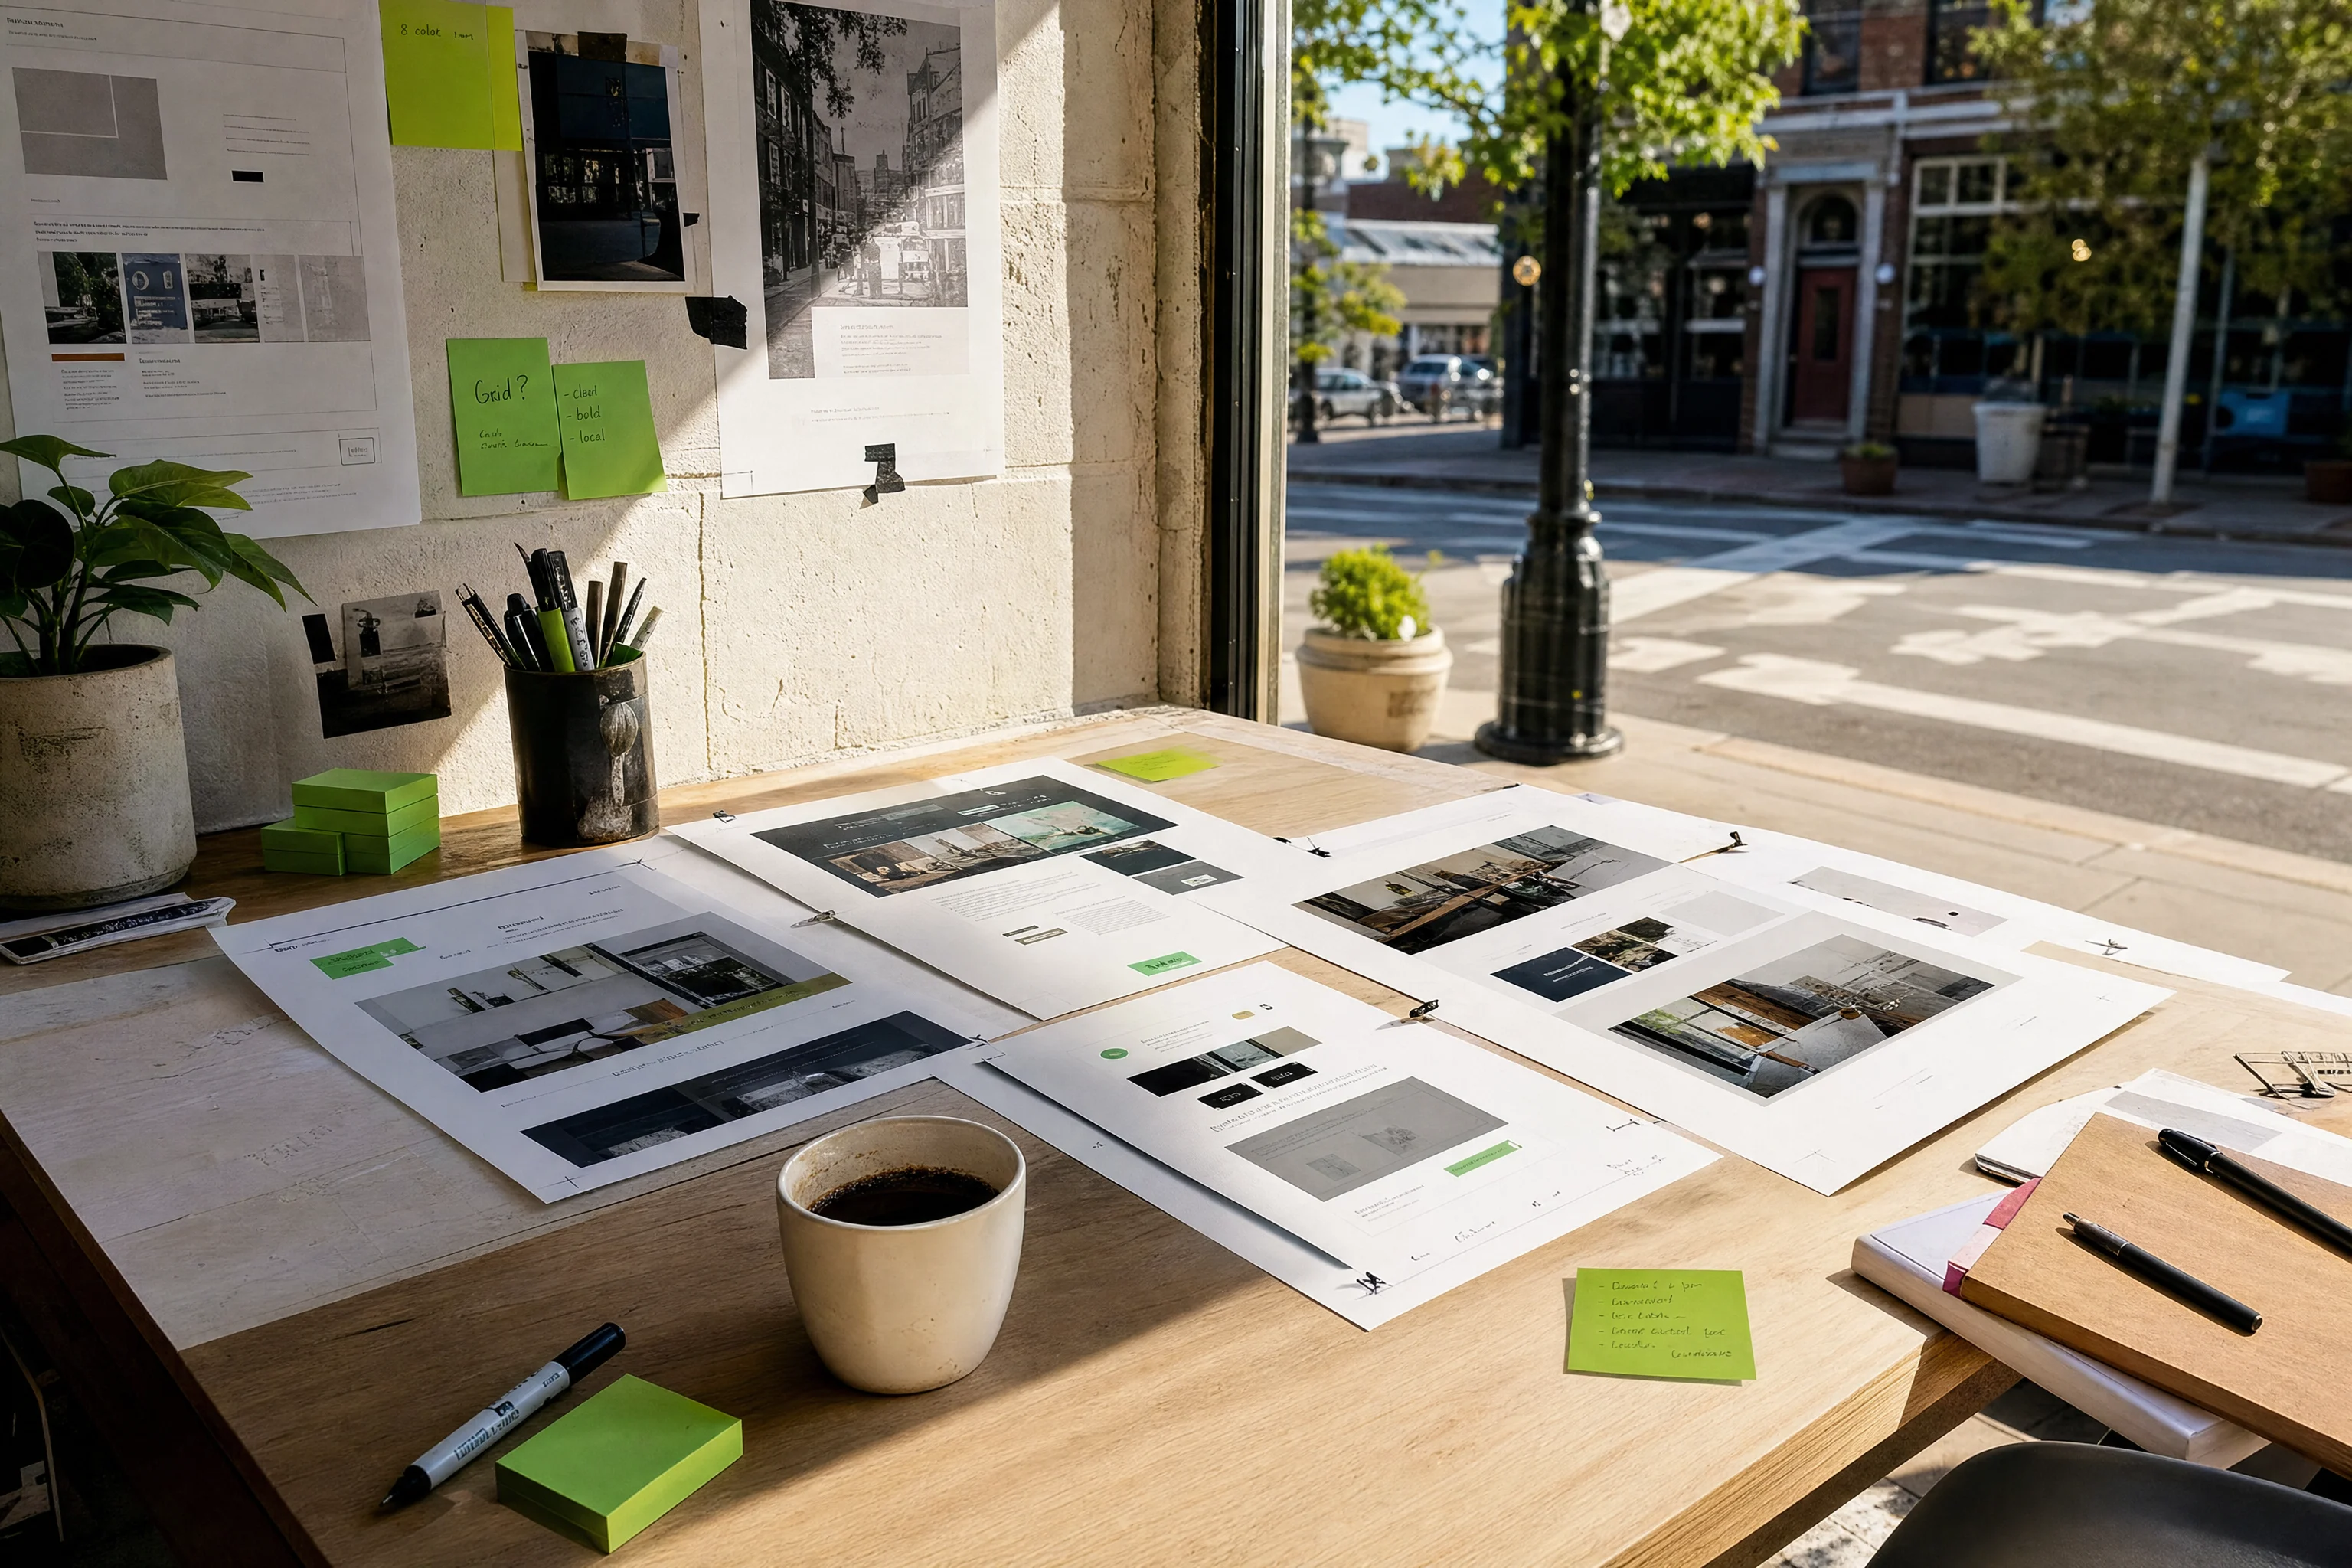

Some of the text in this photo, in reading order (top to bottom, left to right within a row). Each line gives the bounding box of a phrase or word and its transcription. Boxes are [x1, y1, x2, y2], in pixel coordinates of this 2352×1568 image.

[400, 24, 408, 36] 8
[576, 404, 601, 421] bold
[580, 427, 606, 443] local
